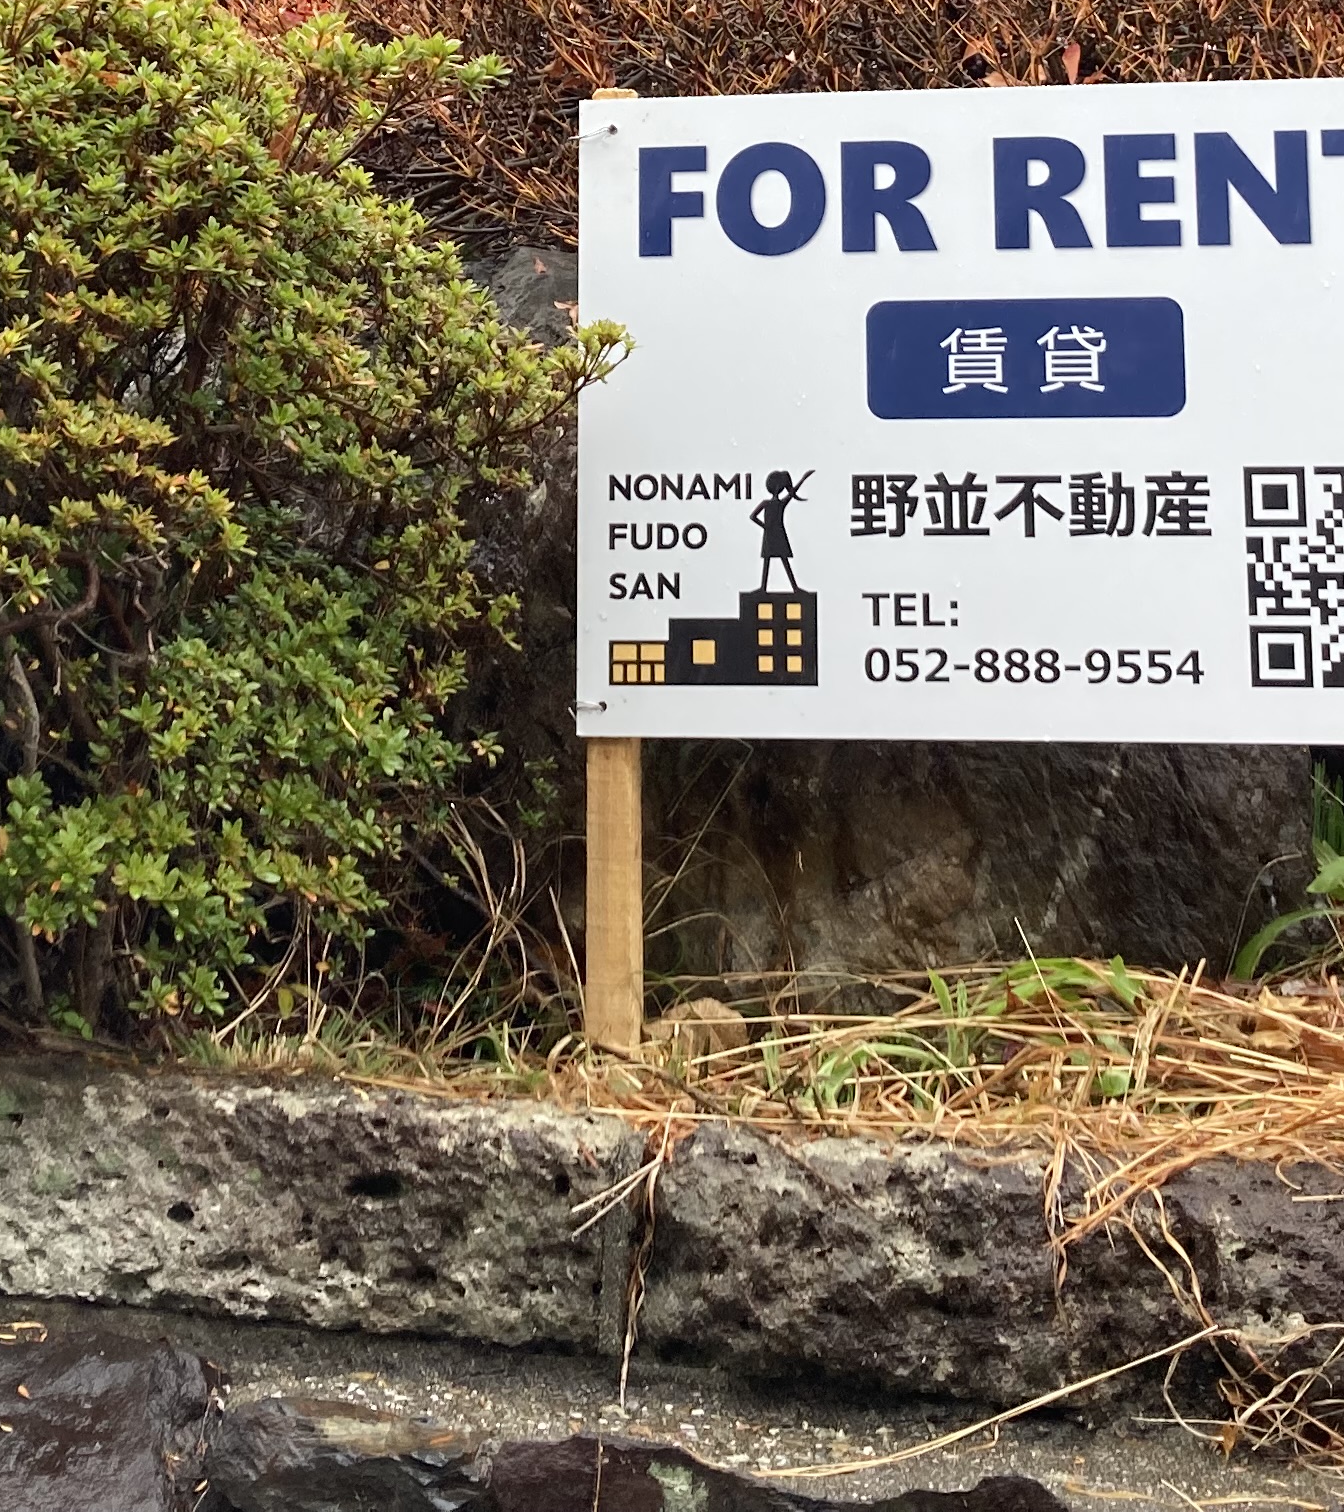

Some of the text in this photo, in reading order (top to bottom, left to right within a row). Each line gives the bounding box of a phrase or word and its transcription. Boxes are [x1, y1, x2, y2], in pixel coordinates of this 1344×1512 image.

[638, 140, 938, 258] FOR
[939, 325, 1109, 396] 賃貸
[609, 473, 753, 502] NONAMI
[850, 470, 1213, 540] 野並不動産
[609, 522, 709, 552] FUDO
[609, 572, 682, 601] SAN
[862, 593, 960, 629] TEL:
[864, 648, 1206, 686] 052-888-9554
